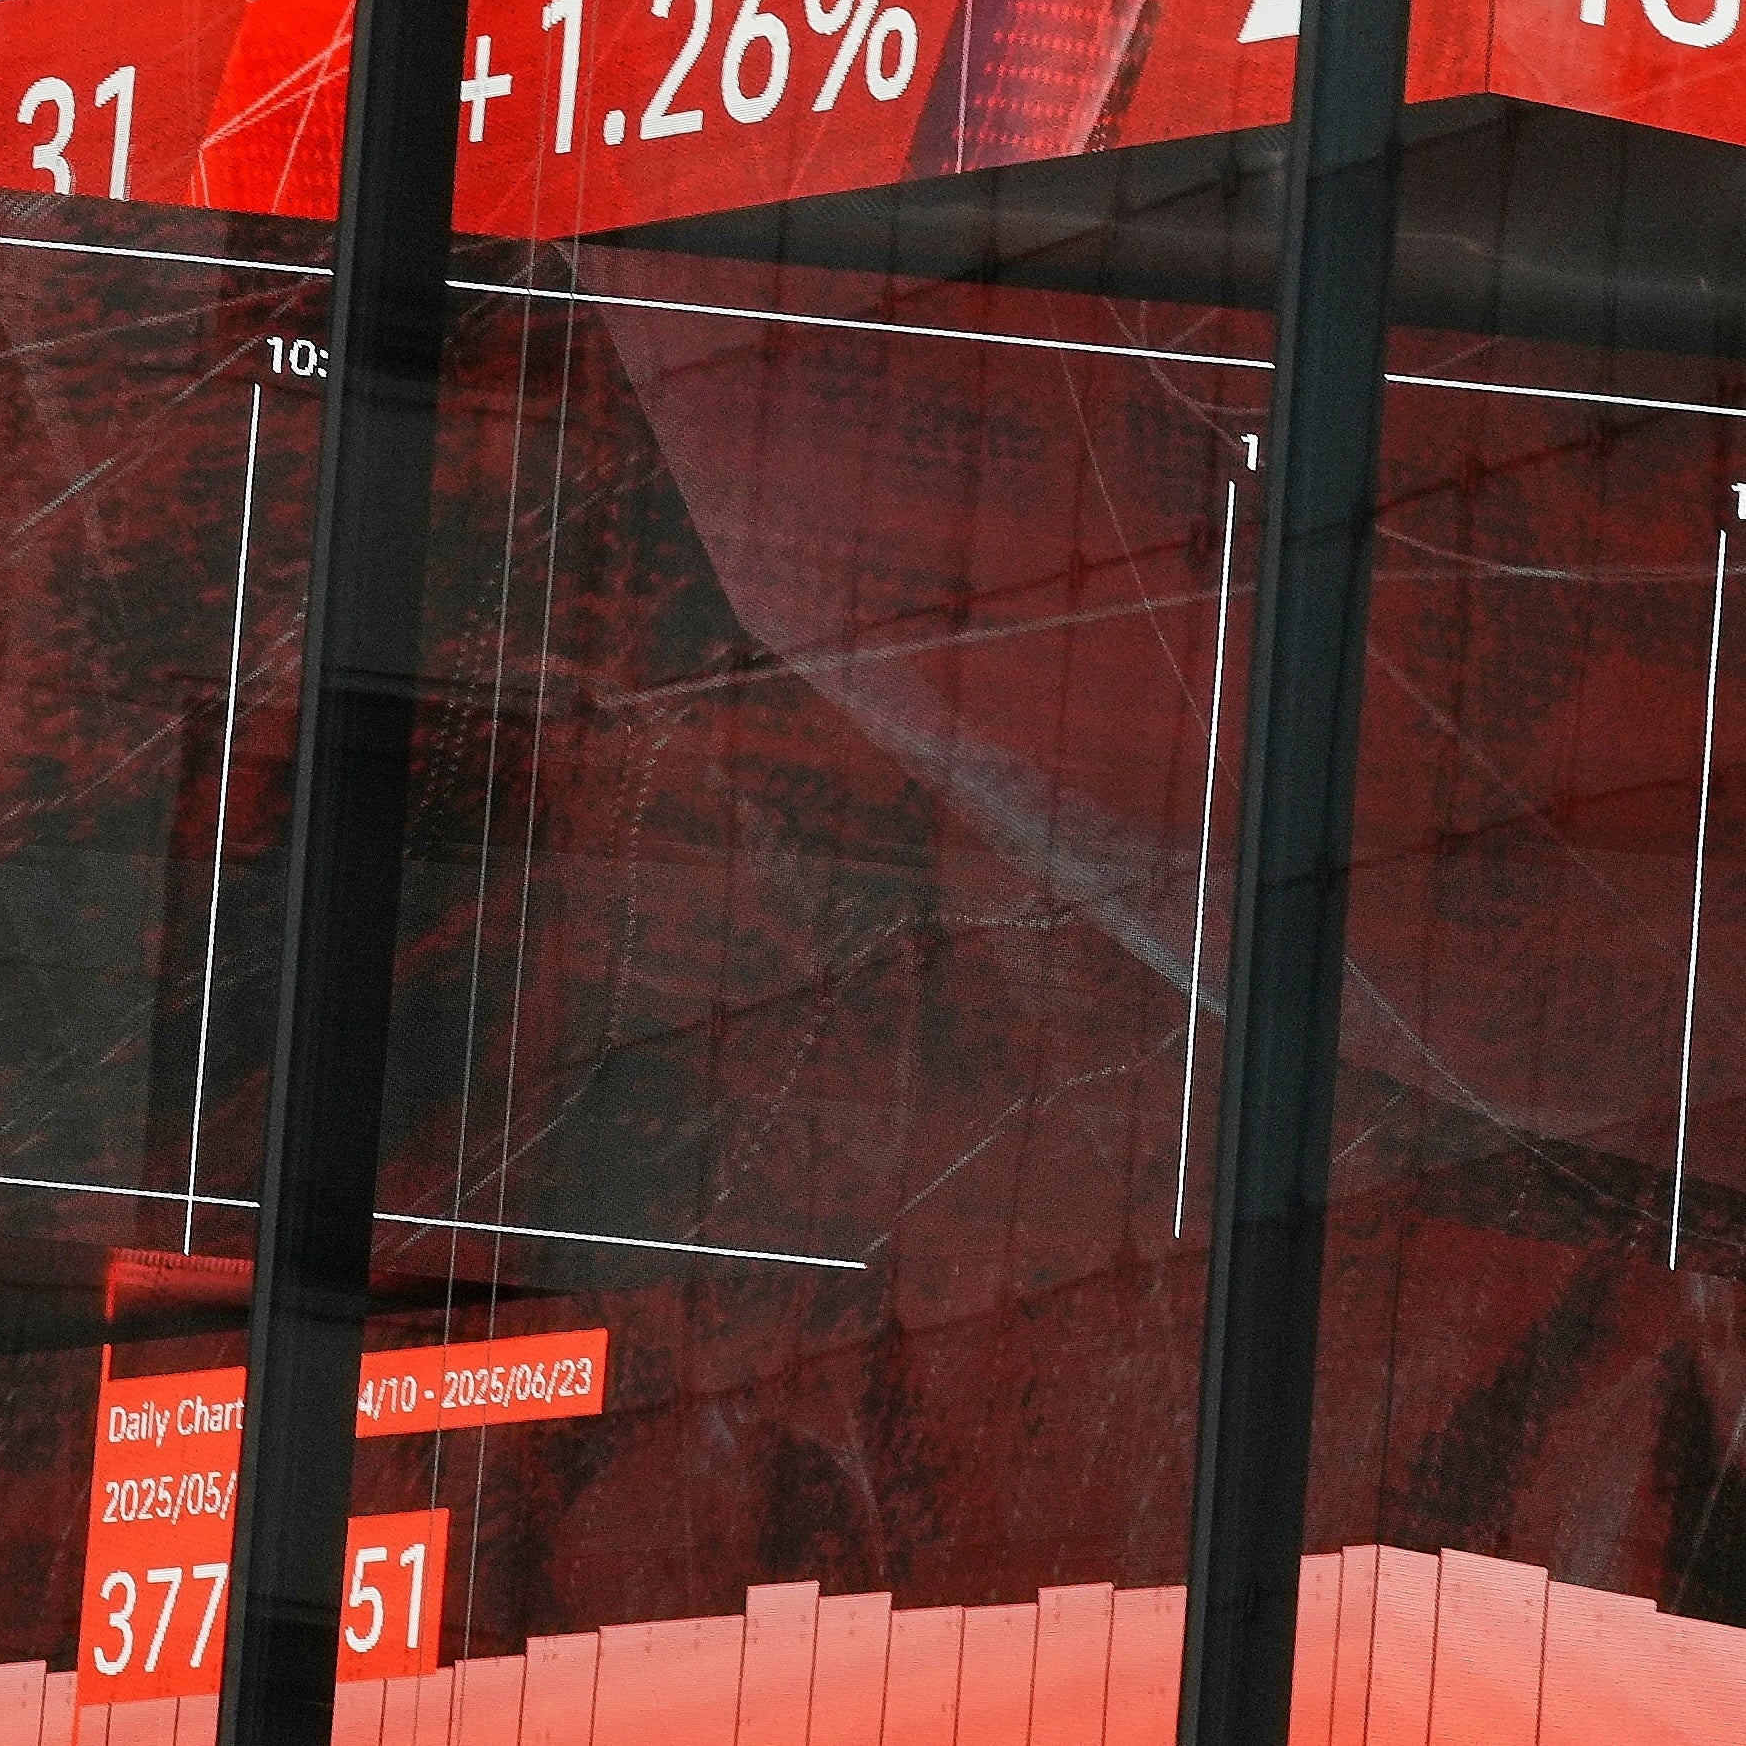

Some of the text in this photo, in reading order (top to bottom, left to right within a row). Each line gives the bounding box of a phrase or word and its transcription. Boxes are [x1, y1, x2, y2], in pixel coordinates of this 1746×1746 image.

[266, 336, 329, 378] 10:
[109, 1399, 171, 1448] Daily
[176, 1394, 245, 1436] Chart
[441, 1356, 593, 1408] 2025/06/23
[101, 1469, 238, 1526] 2025/05/
